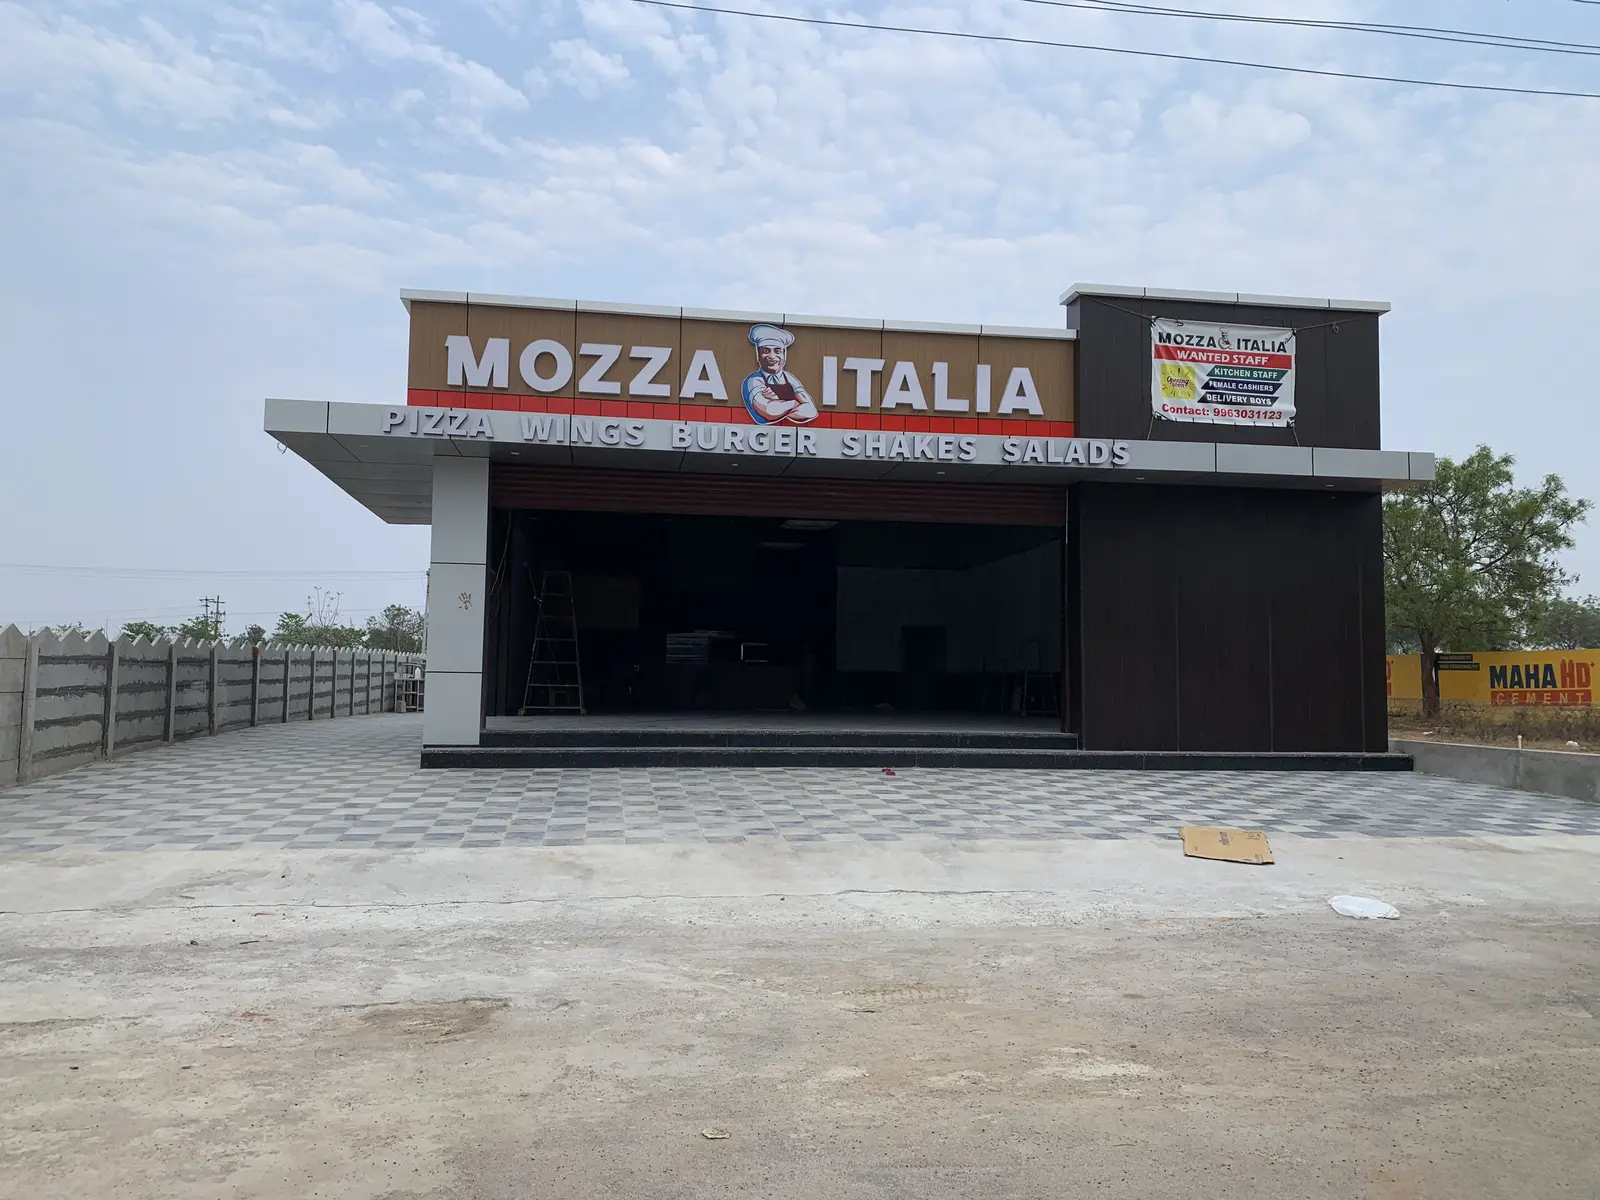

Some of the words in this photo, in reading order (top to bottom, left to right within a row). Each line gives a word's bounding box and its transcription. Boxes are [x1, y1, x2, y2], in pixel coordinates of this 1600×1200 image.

[1159, 332, 1216, 348] MOZZA
[1237, 338, 1287, 353] ITALIA
[1177, 350, 1230, 363] WANTED
[1233, 355, 1268, 365] STAFF
[445, 335, 729, 401] MOZZA
[822, 355, 1045, 416] ITALIA
[1215, 368, 1251, 377] KITCHEN
[1209, 381, 1236, 389] FEMALE
[1238, 383, 1273, 391] CASHIERS
[1207, 394, 1247, 403] DELIVERY
[1250, 397, 1271, 405] BOYS
[1162, 404, 1209, 416] Contact:
[1213, 408, 1282, 419] 9963031123
[382, 408, 494, 438] PIZZA
[521, 414, 645, 446] WINGS
[672, 424, 818, 455] BURGER
[842, 433, 978, 461] SHAKES
[1002, 438, 1131, 466] SALADS
[1496, 692, 1585, 705] CEMENT
